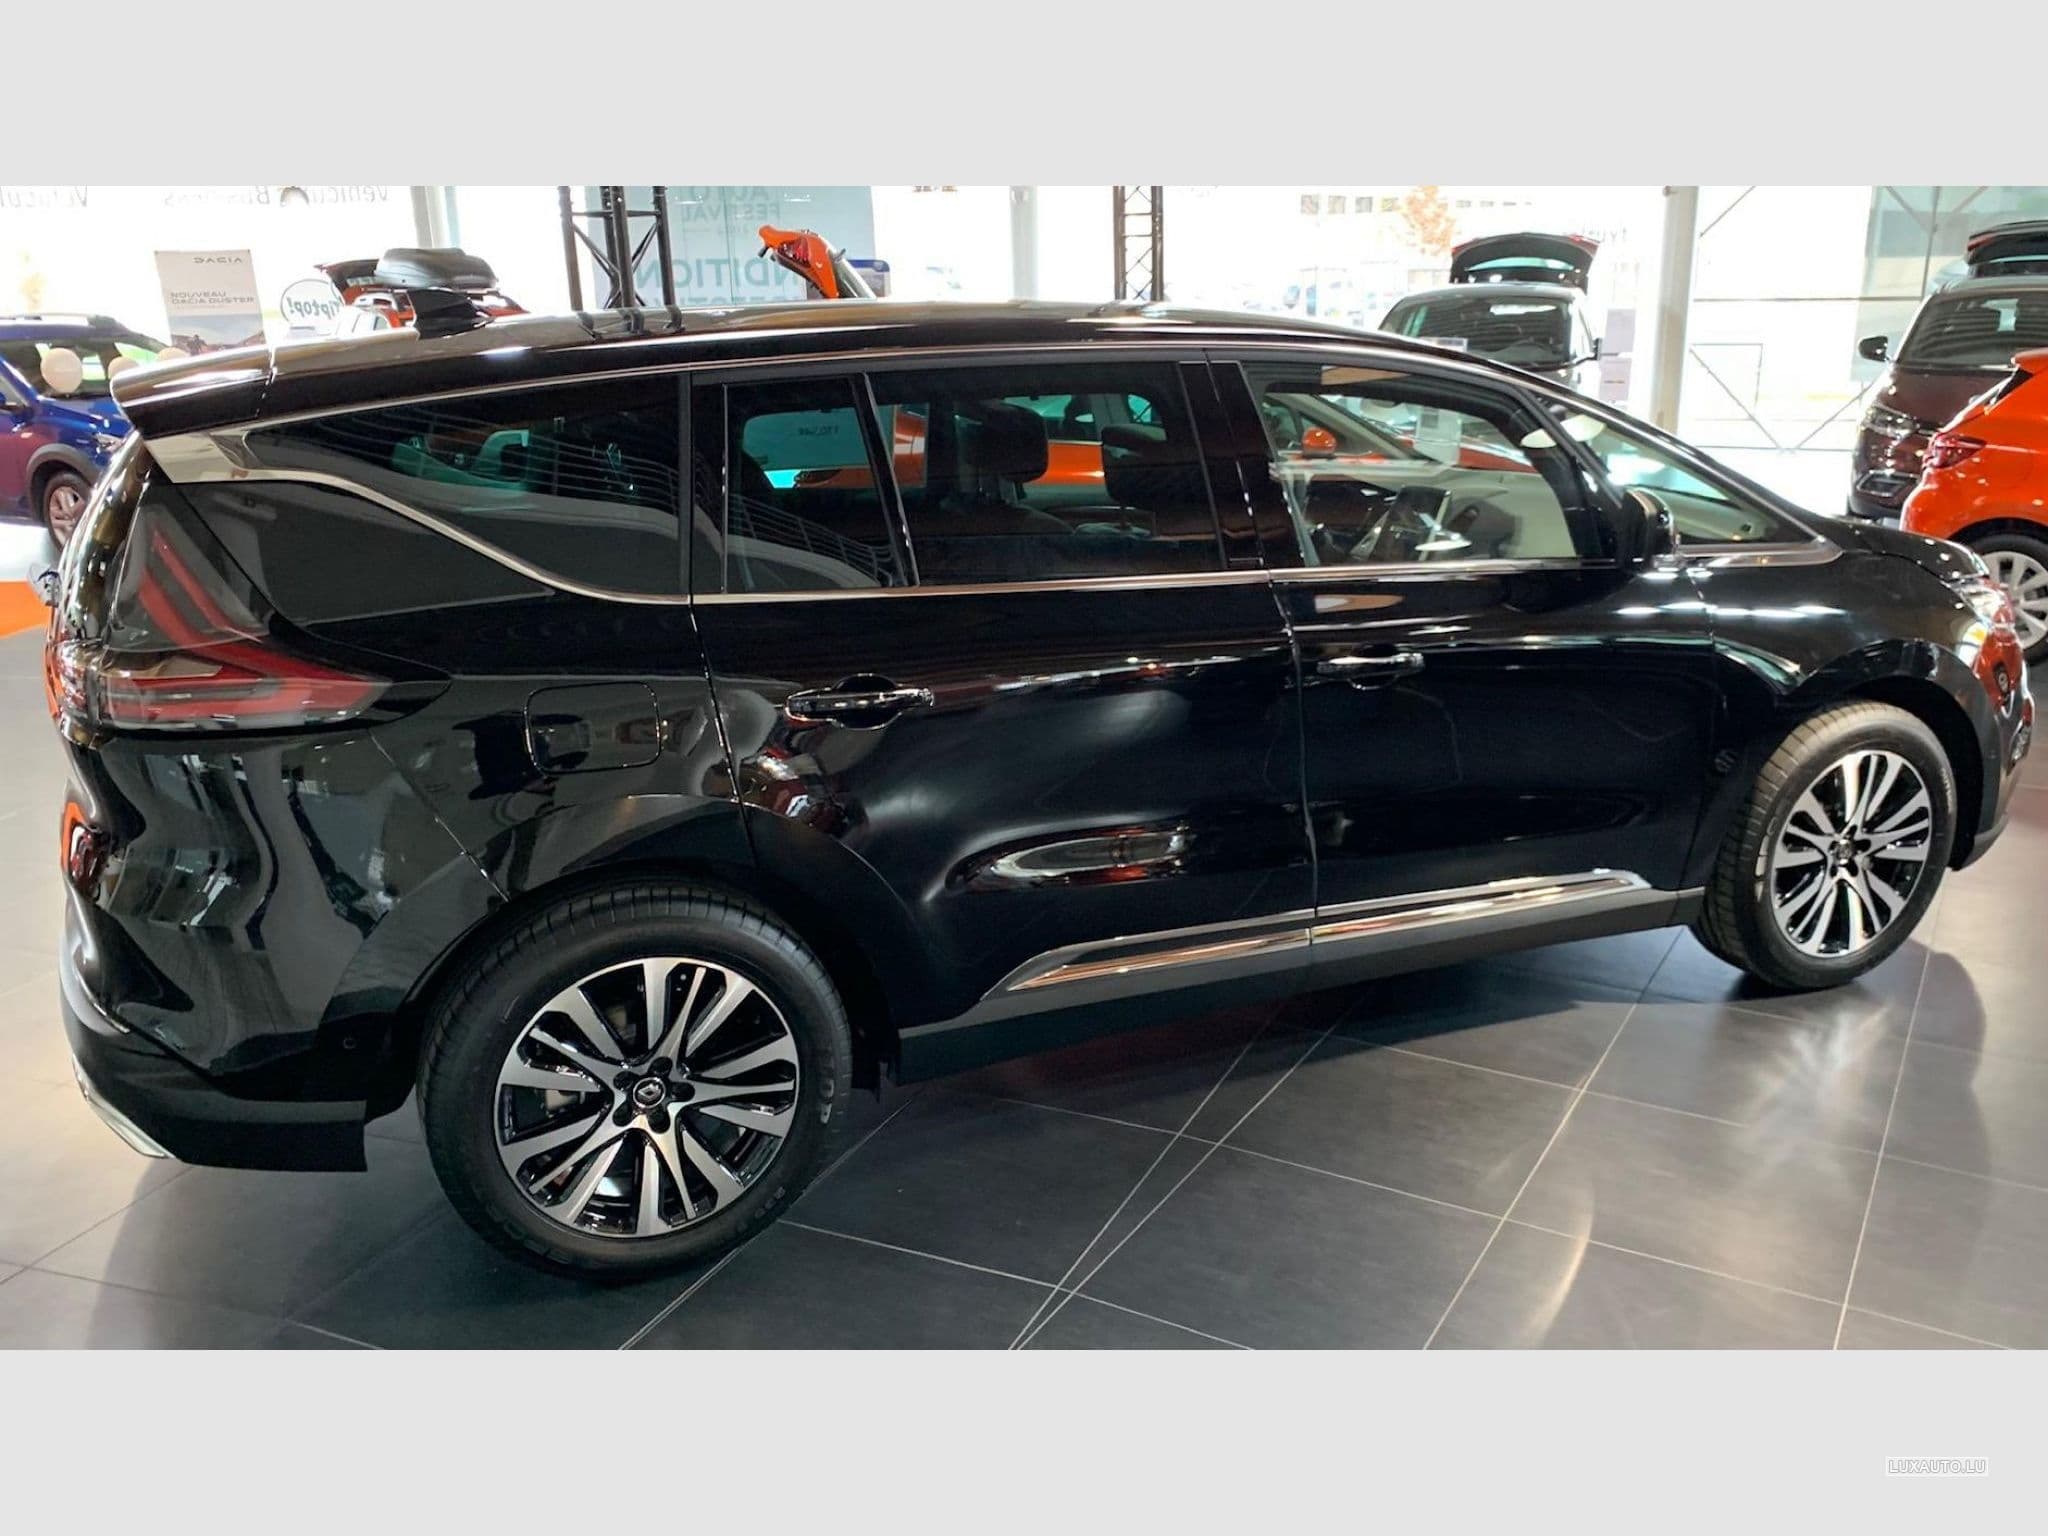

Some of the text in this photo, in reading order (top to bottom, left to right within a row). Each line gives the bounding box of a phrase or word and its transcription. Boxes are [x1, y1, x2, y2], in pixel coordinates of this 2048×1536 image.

[193, 256, 243, 264] DACIA
[169, 291, 227, 299] NOUVEAU
[171, 295, 254, 305] DACIA DUSTER
